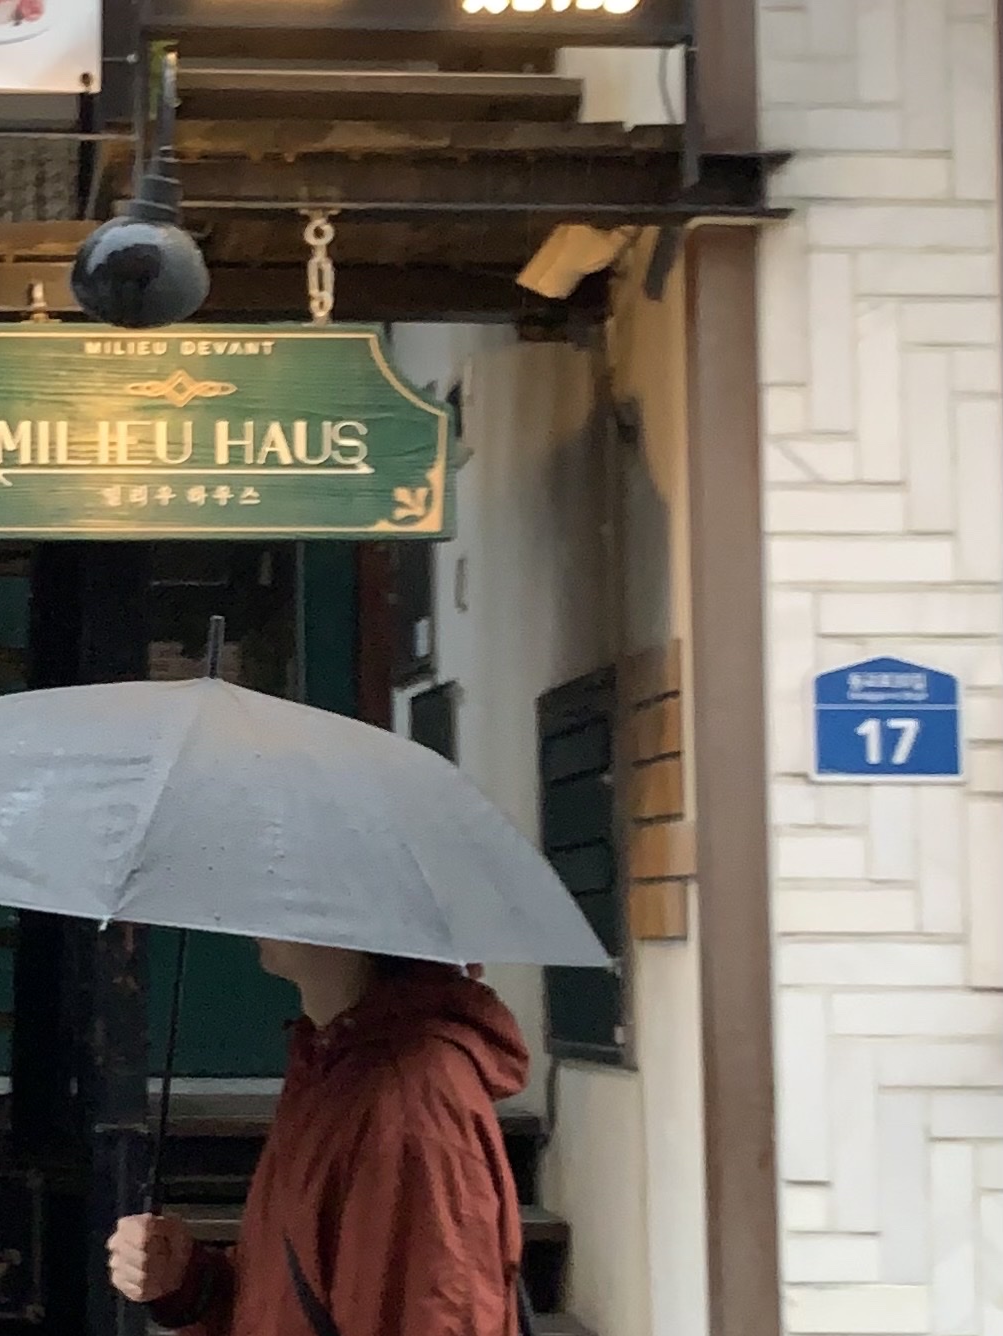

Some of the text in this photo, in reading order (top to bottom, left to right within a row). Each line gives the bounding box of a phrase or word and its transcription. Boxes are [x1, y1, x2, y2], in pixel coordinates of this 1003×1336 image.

[84, 341, 275, 355] MILIEU DEVANT
[214, 420, 369, 465] HAUS
[186, 484, 262, 507] 하우스
[854, 717, 921, 765] 17
